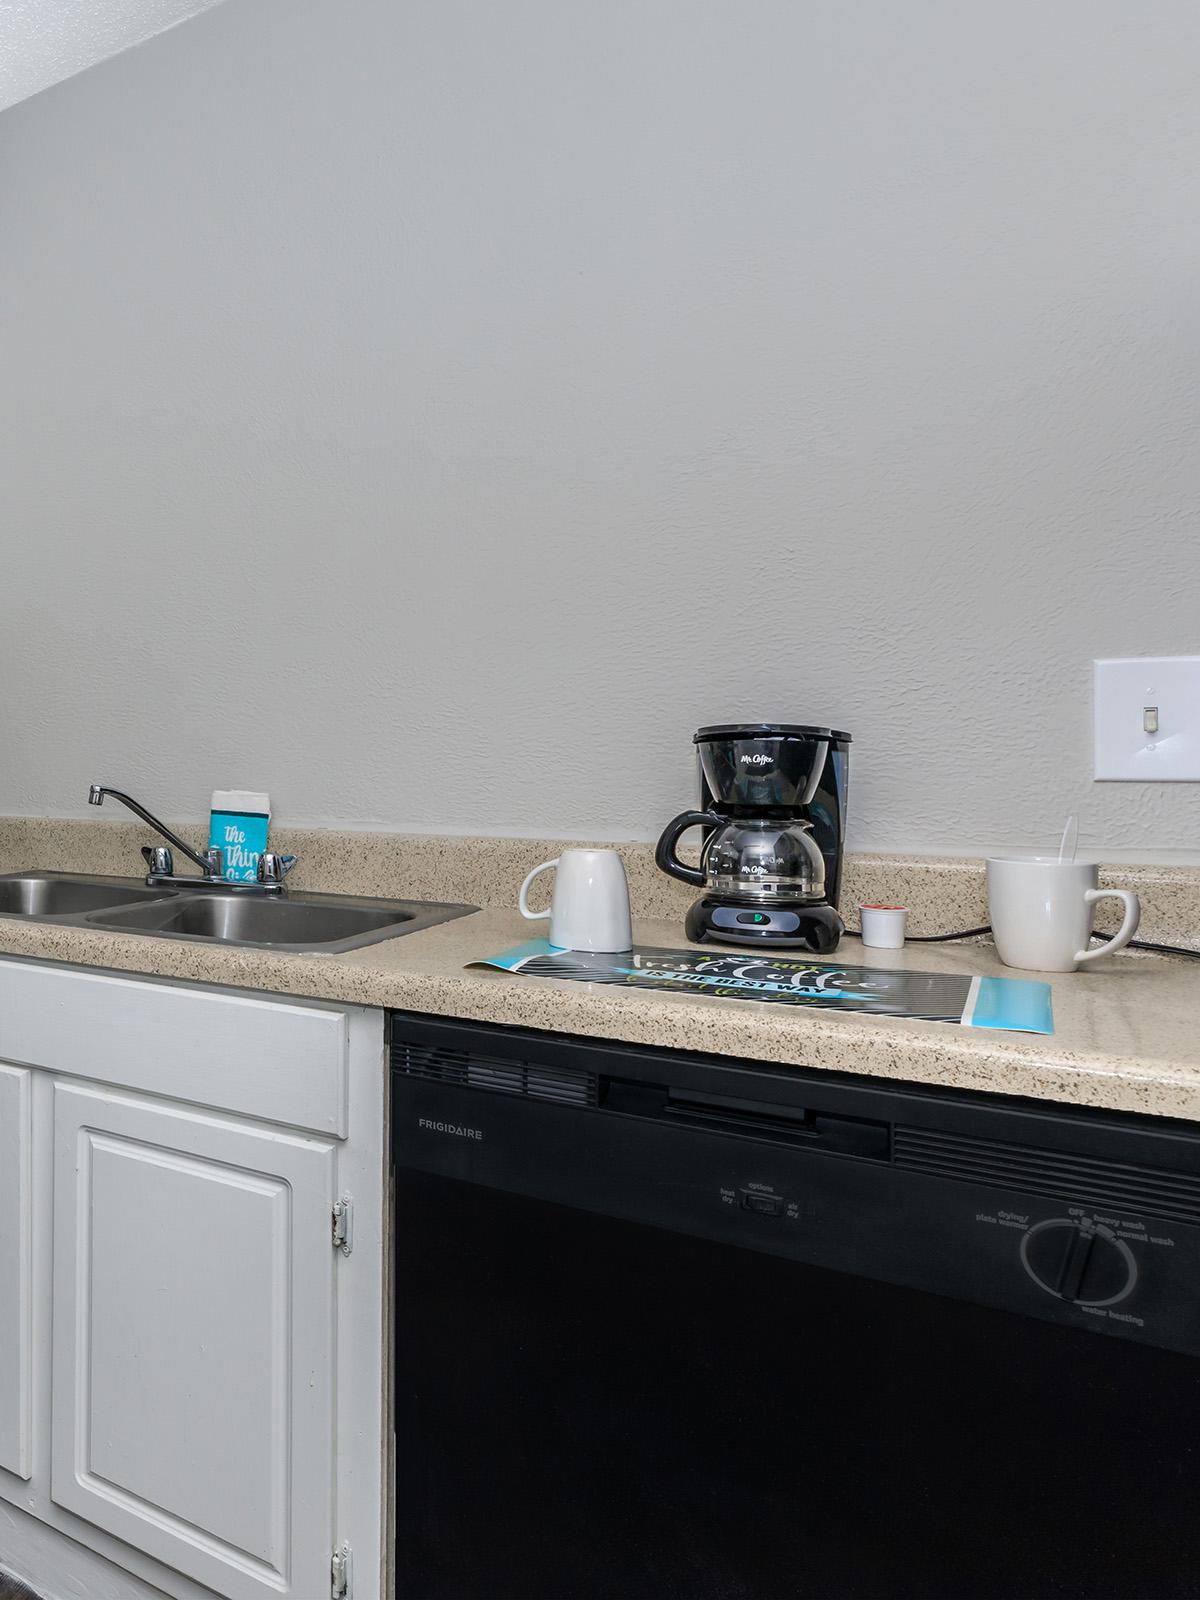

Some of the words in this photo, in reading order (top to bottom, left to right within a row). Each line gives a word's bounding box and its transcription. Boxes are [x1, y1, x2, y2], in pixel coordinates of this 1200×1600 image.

[752, 754, 775, 766] Coffee
[672, 973, 712, 982] THE
[715, 977, 767, 989] BEST
[777, 984, 827, 994] WAY
[418, 1118, 483, 1140] FRIGIDAIRE
[719, 1186, 736, 1197] heat
[748, 1182, 774, 1193] options
[721, 1195, 734, 1204] dry
[786, 1209, 800, 1219] dry
[1068, 1207, 1086, 1217] OFF
[975, 1213, 997, 1224] plate
[1093, 1213, 1120, 1227] heavy
[1121, 1220, 1145, 1231] wash
[1116, 1230, 1149, 1242] normal
[1150, 1236, 1175, 1247] wash
[1081, 1305, 1107, 1317] water
[1108, 1309, 1144, 1327] heating
